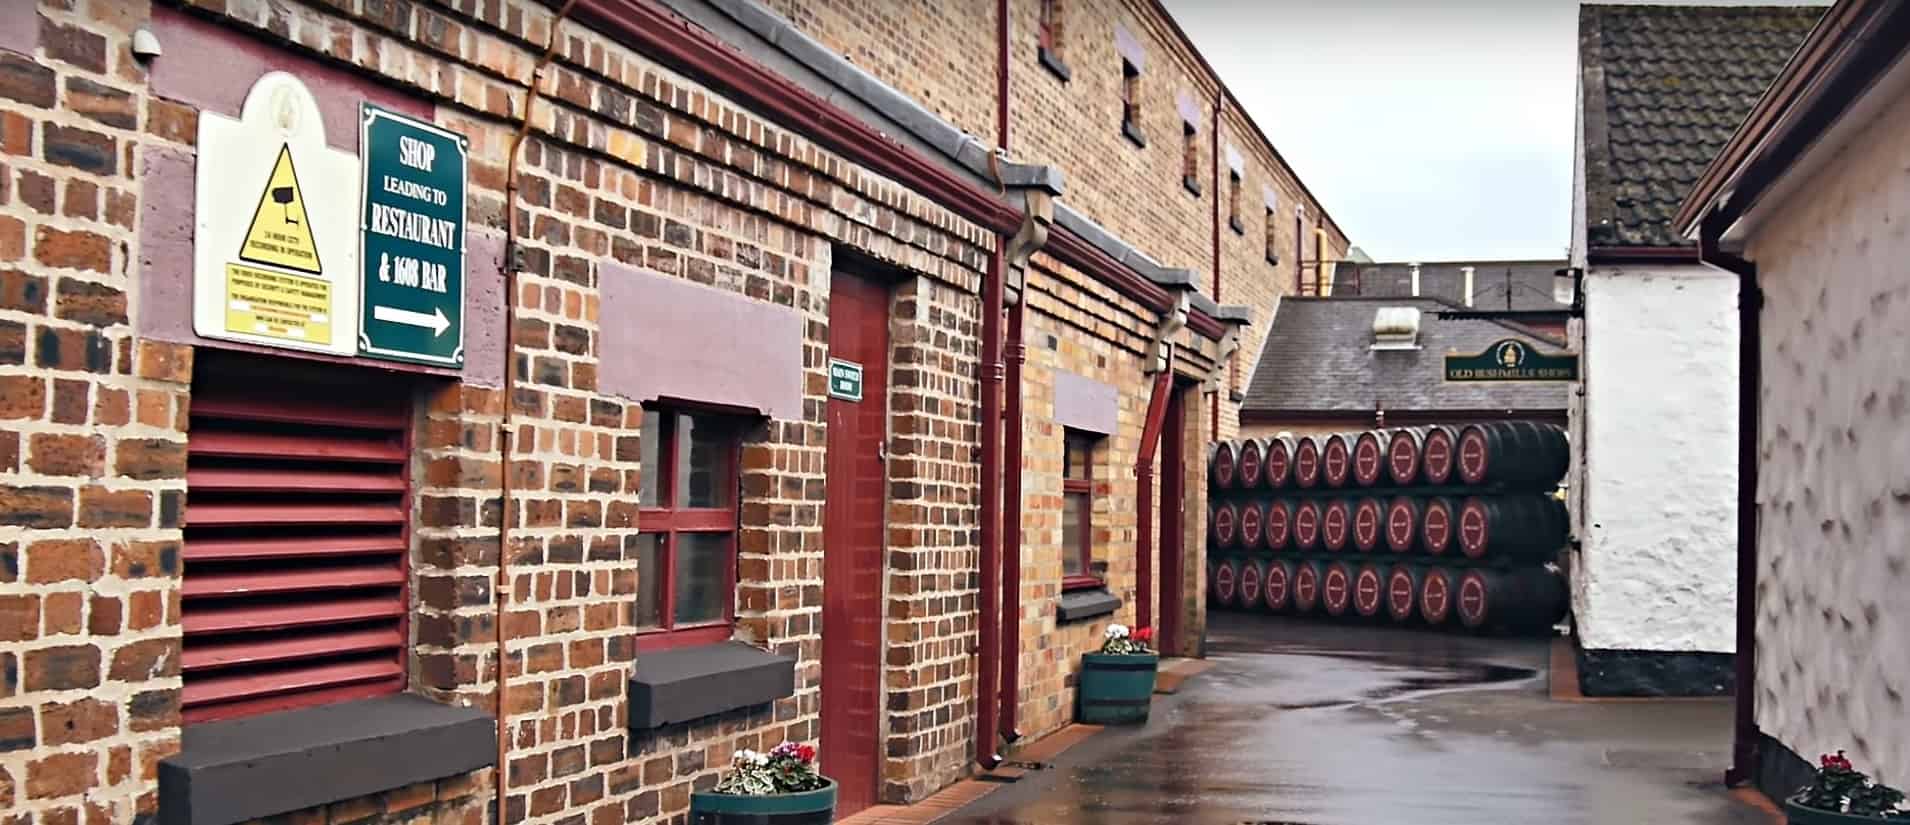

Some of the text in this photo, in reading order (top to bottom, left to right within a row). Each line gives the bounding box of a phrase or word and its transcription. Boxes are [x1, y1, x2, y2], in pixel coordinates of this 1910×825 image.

[399, 135, 436, 172] SHOP
[383, 175, 447, 206] LEADING TO
[371, 202, 456, 250] RESTAURANT
[378, 251, 447, 293] & 1608 BAR
